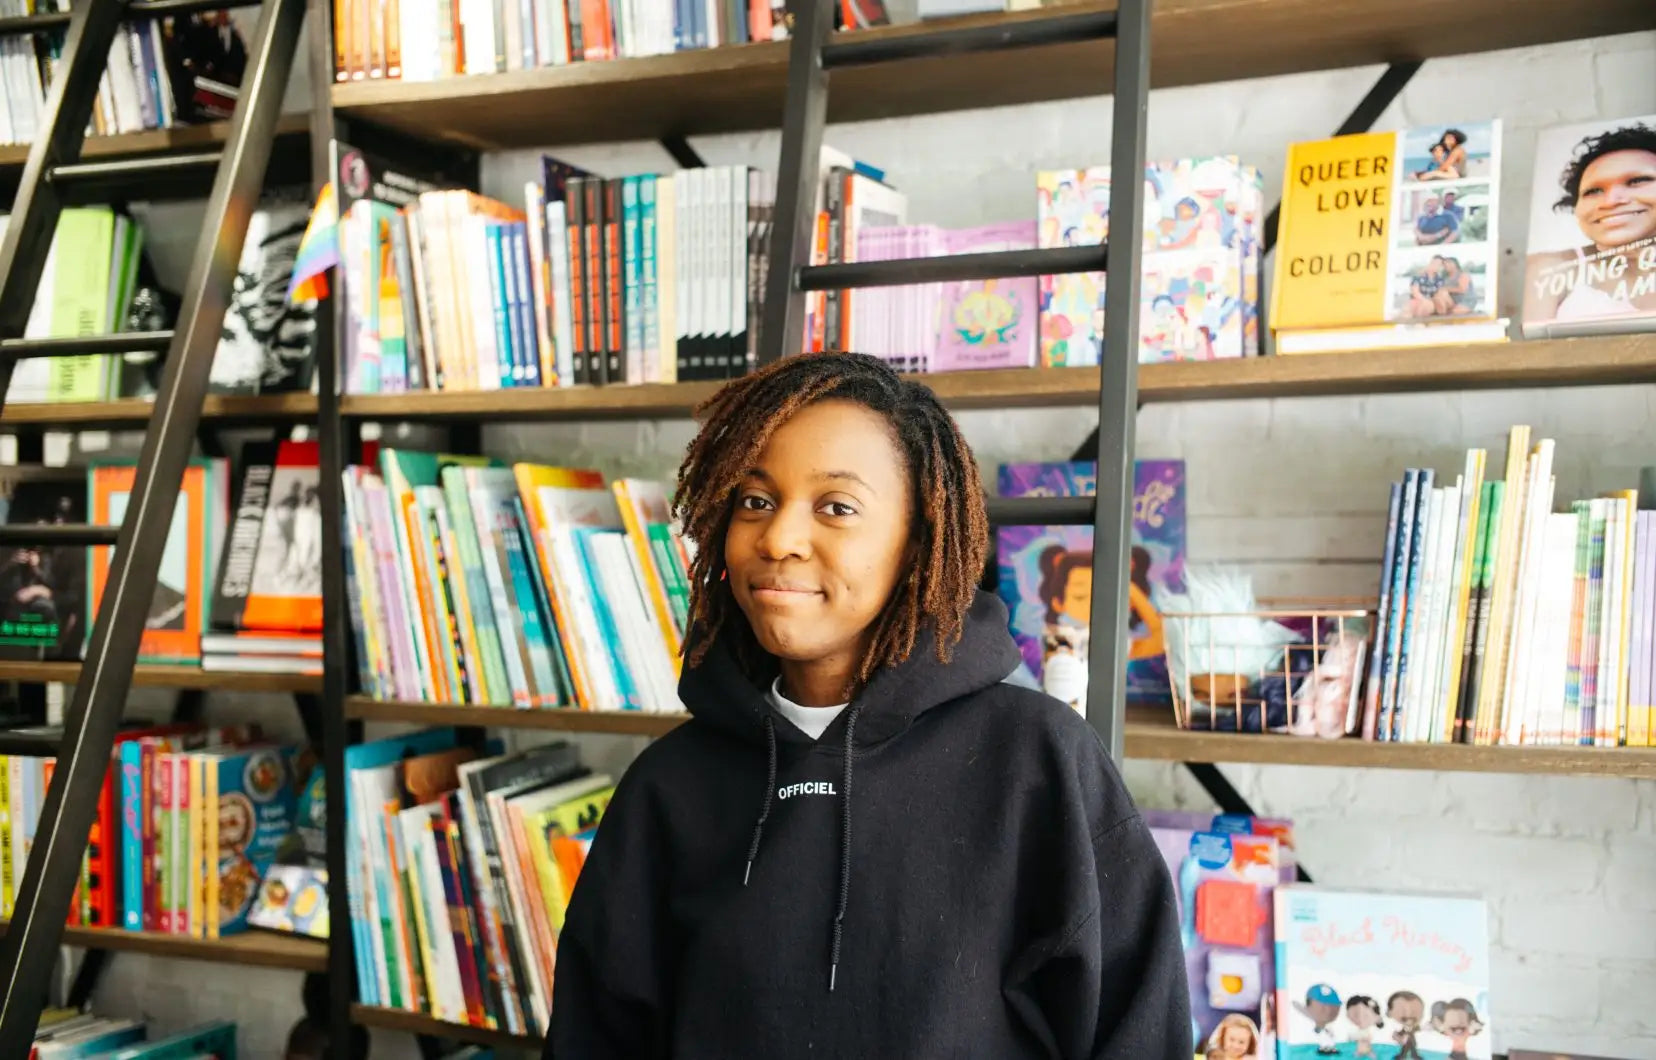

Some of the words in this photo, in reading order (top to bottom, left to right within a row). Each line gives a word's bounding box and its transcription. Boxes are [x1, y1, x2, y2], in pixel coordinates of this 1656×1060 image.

[1299, 155, 1389, 187] QUEER
[1316, 186, 1386, 213] LOVE
[1358, 217, 1384, 239] IN
[1289, 249, 1381, 278] COLOR
[777, 781, 838, 800] OFFICIEL
[1301, 916, 1375, 960] Black
